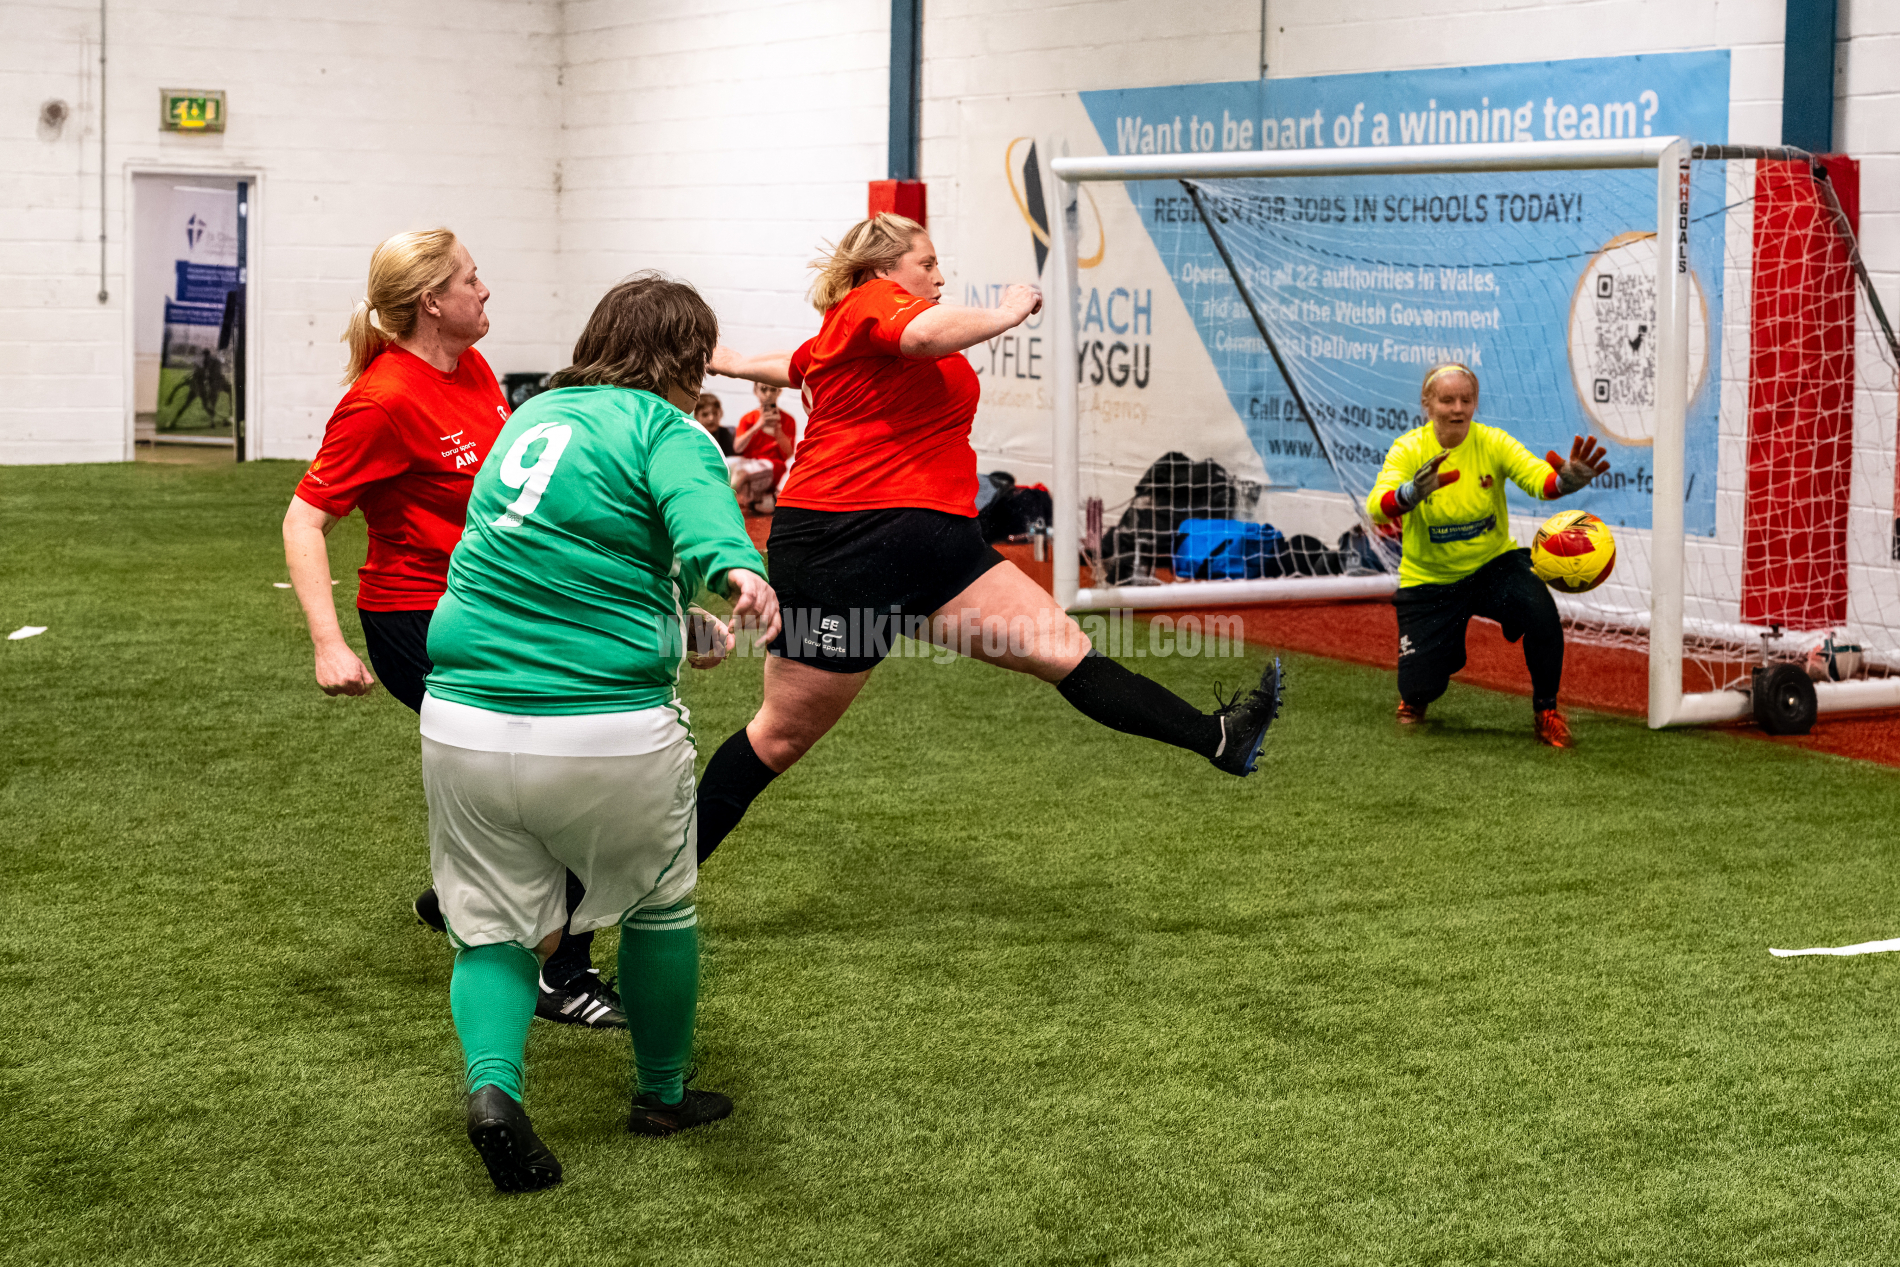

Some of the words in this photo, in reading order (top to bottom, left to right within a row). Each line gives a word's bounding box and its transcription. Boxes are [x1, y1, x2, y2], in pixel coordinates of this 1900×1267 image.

[1117, 116, 1182, 154] Want
[1190, 115, 1214, 152] to
[1222, 109, 1253, 151] be
[1262, 109, 1324, 151] part
[1333, 102, 1365, 147] of
[1371, 112, 1389, 146] a
[1399, 97, 1534, 144] winning
[1543, 89, 1659, 139] team?
[1292, 195, 1346, 223] JOBS
[1353, 194, 1378, 223] IN
[1382, 192, 1488, 223] SCHOOLS
[1495, 192, 1583, 223] TODAY!
[1296, 264, 1318, 289] 22
[1322, 264, 1414, 291] authorities
[1417, 267, 1435, 291] in
[1440, 268, 1500, 297] Wales,
[1303, 299, 1331, 322] the
[1335, 300, 1386, 325] Welsh
[1391, 302, 1500, 330] Government
[1311, 335, 1379, 367] Delivery
[1383, 338, 1483, 367] Framework
[1376, 407, 1409, 431] 500
[456, 450, 479, 470] AM
[490, 421, 573, 528] 9
[820, 618, 840, 632] EE
[822, 644, 846, 653] sports
